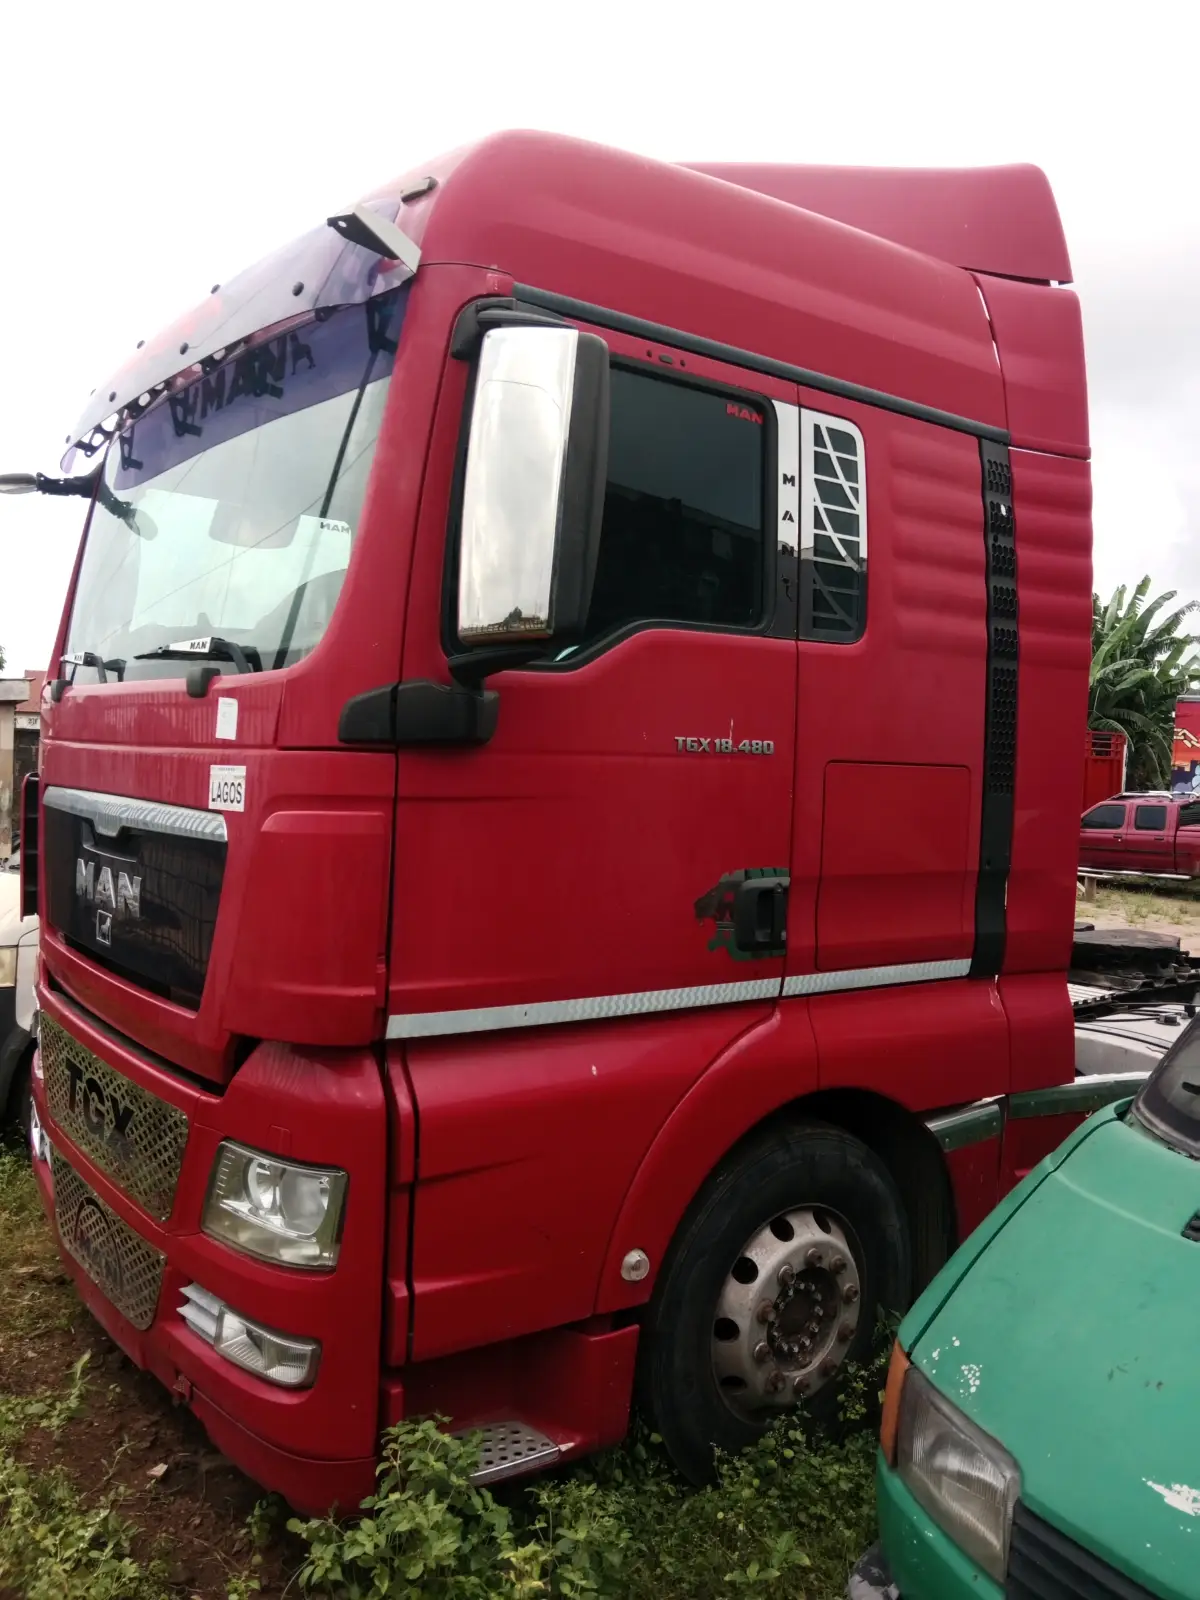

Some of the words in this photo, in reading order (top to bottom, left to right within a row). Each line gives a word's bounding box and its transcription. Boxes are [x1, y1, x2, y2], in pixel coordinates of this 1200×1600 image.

[726, 403, 764, 425] MAN
[189, 640, 208, 651] MAN
[674, 736, 712, 753] TGX
[714, 738, 775, 755] 18.480
[211, 782, 243, 804] LAGOS
[75, 858, 142, 921] MAN
[65, 1055, 137, 1152] TGX
